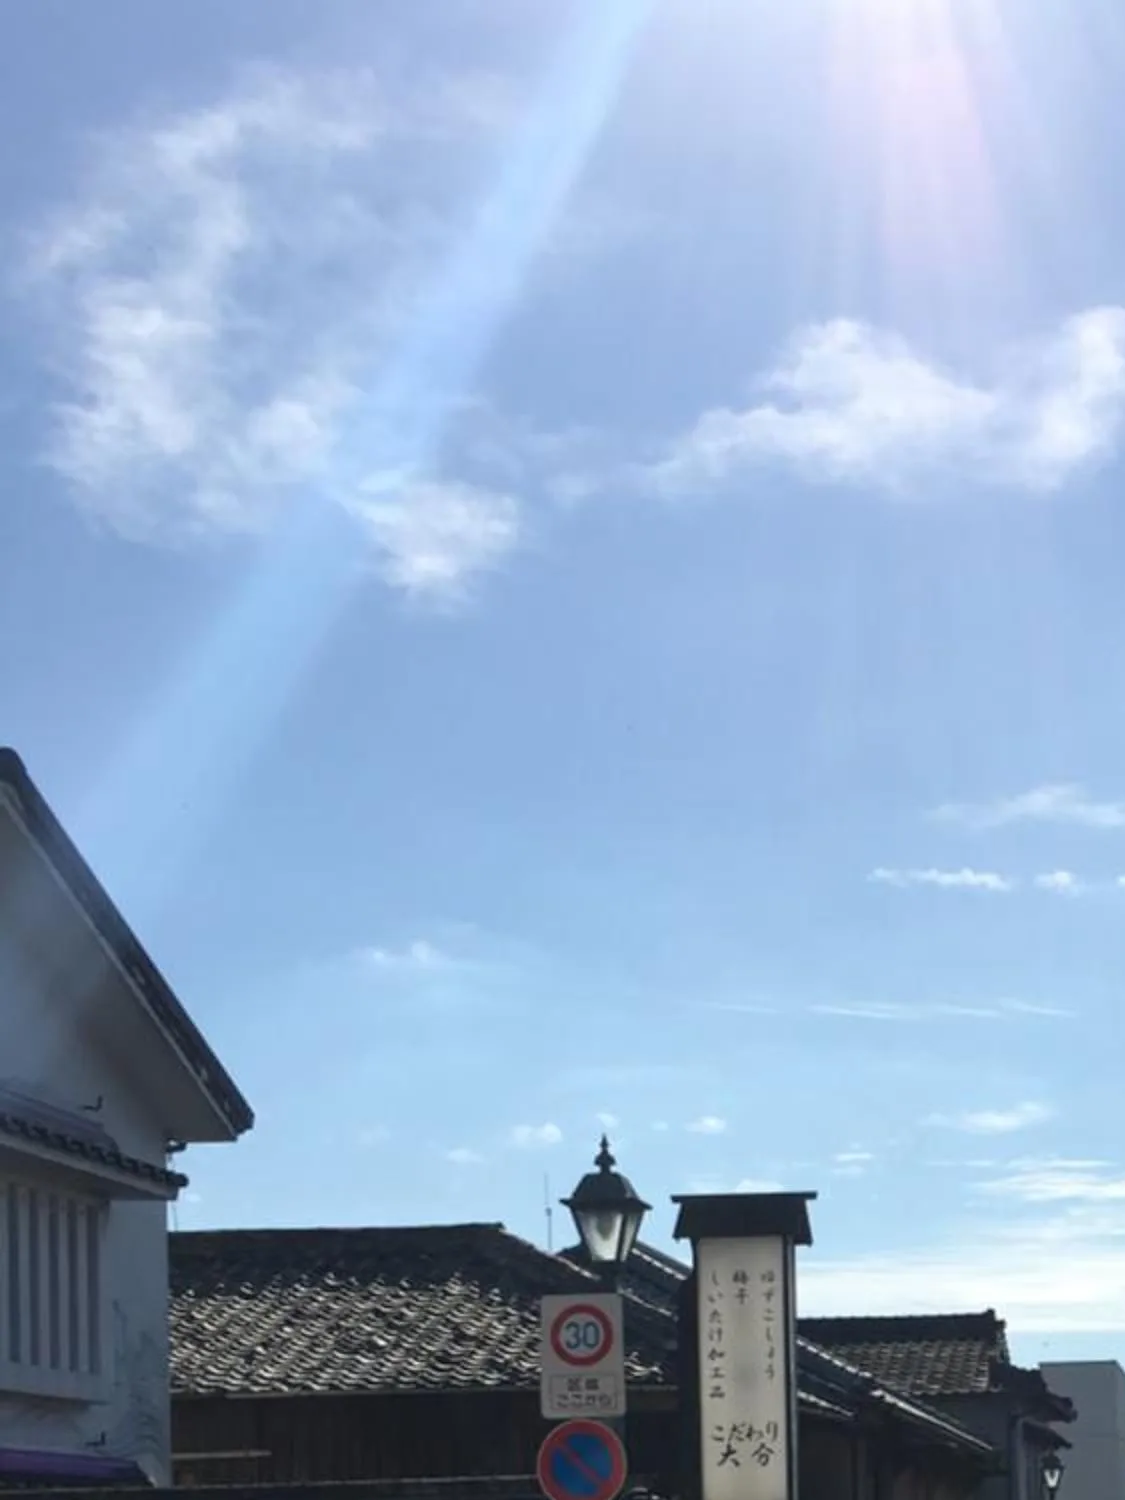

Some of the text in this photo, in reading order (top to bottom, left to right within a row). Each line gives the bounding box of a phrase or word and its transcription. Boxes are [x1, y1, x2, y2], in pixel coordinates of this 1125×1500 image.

[564, 1321, 600, 1349] 30
[711, 1421, 779, 1442] こだわり
[716, 1442, 775, 1468] 大分
